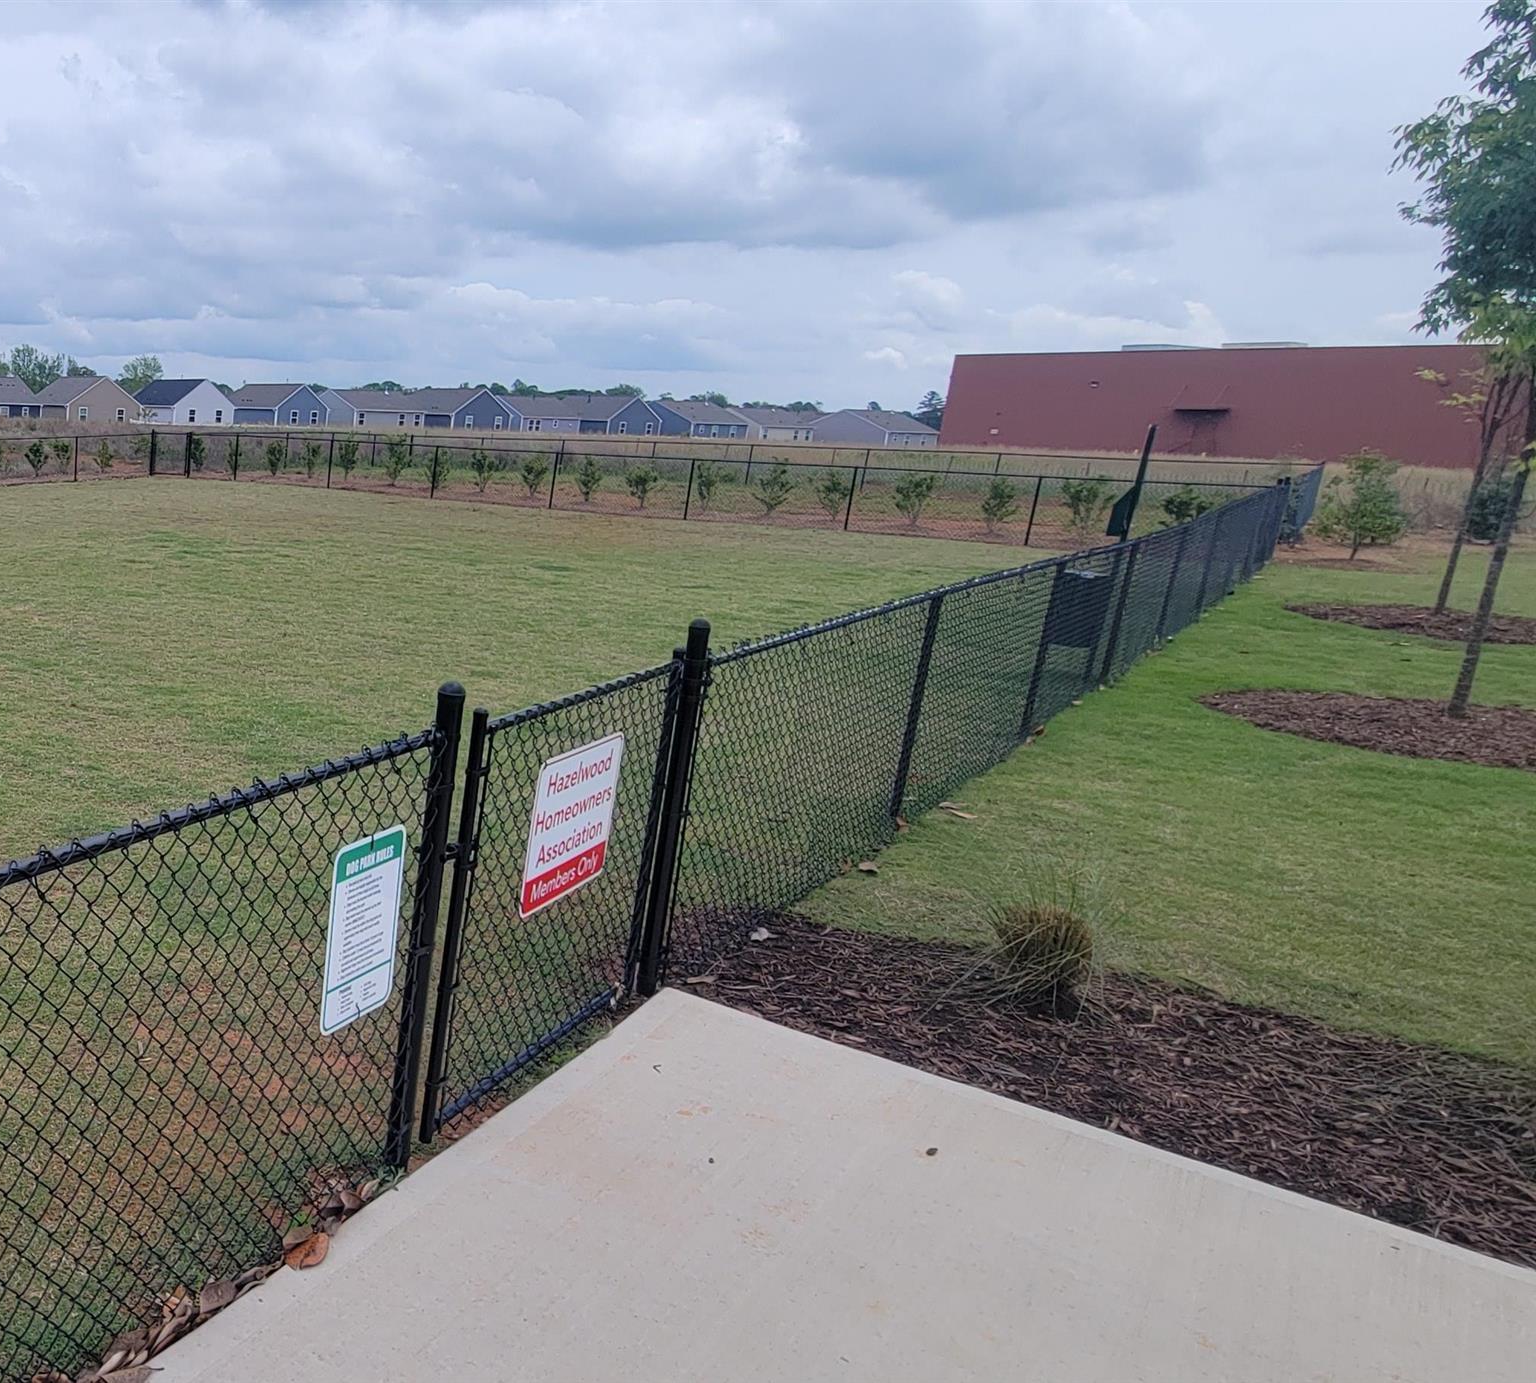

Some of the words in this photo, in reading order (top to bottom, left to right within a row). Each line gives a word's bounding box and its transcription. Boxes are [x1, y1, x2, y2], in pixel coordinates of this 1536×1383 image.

[546, 748, 614, 797] Hazelwood
[534, 785, 613, 836] Homeowners
[345, 856, 360, 876] DOG
[359, 851, 376, 871] PARK
[375, 844, 395, 864] RULES
[535, 820, 603, 868] Association
[530, 865, 576, 903] Members
[577, 851, 599, 877] Only
